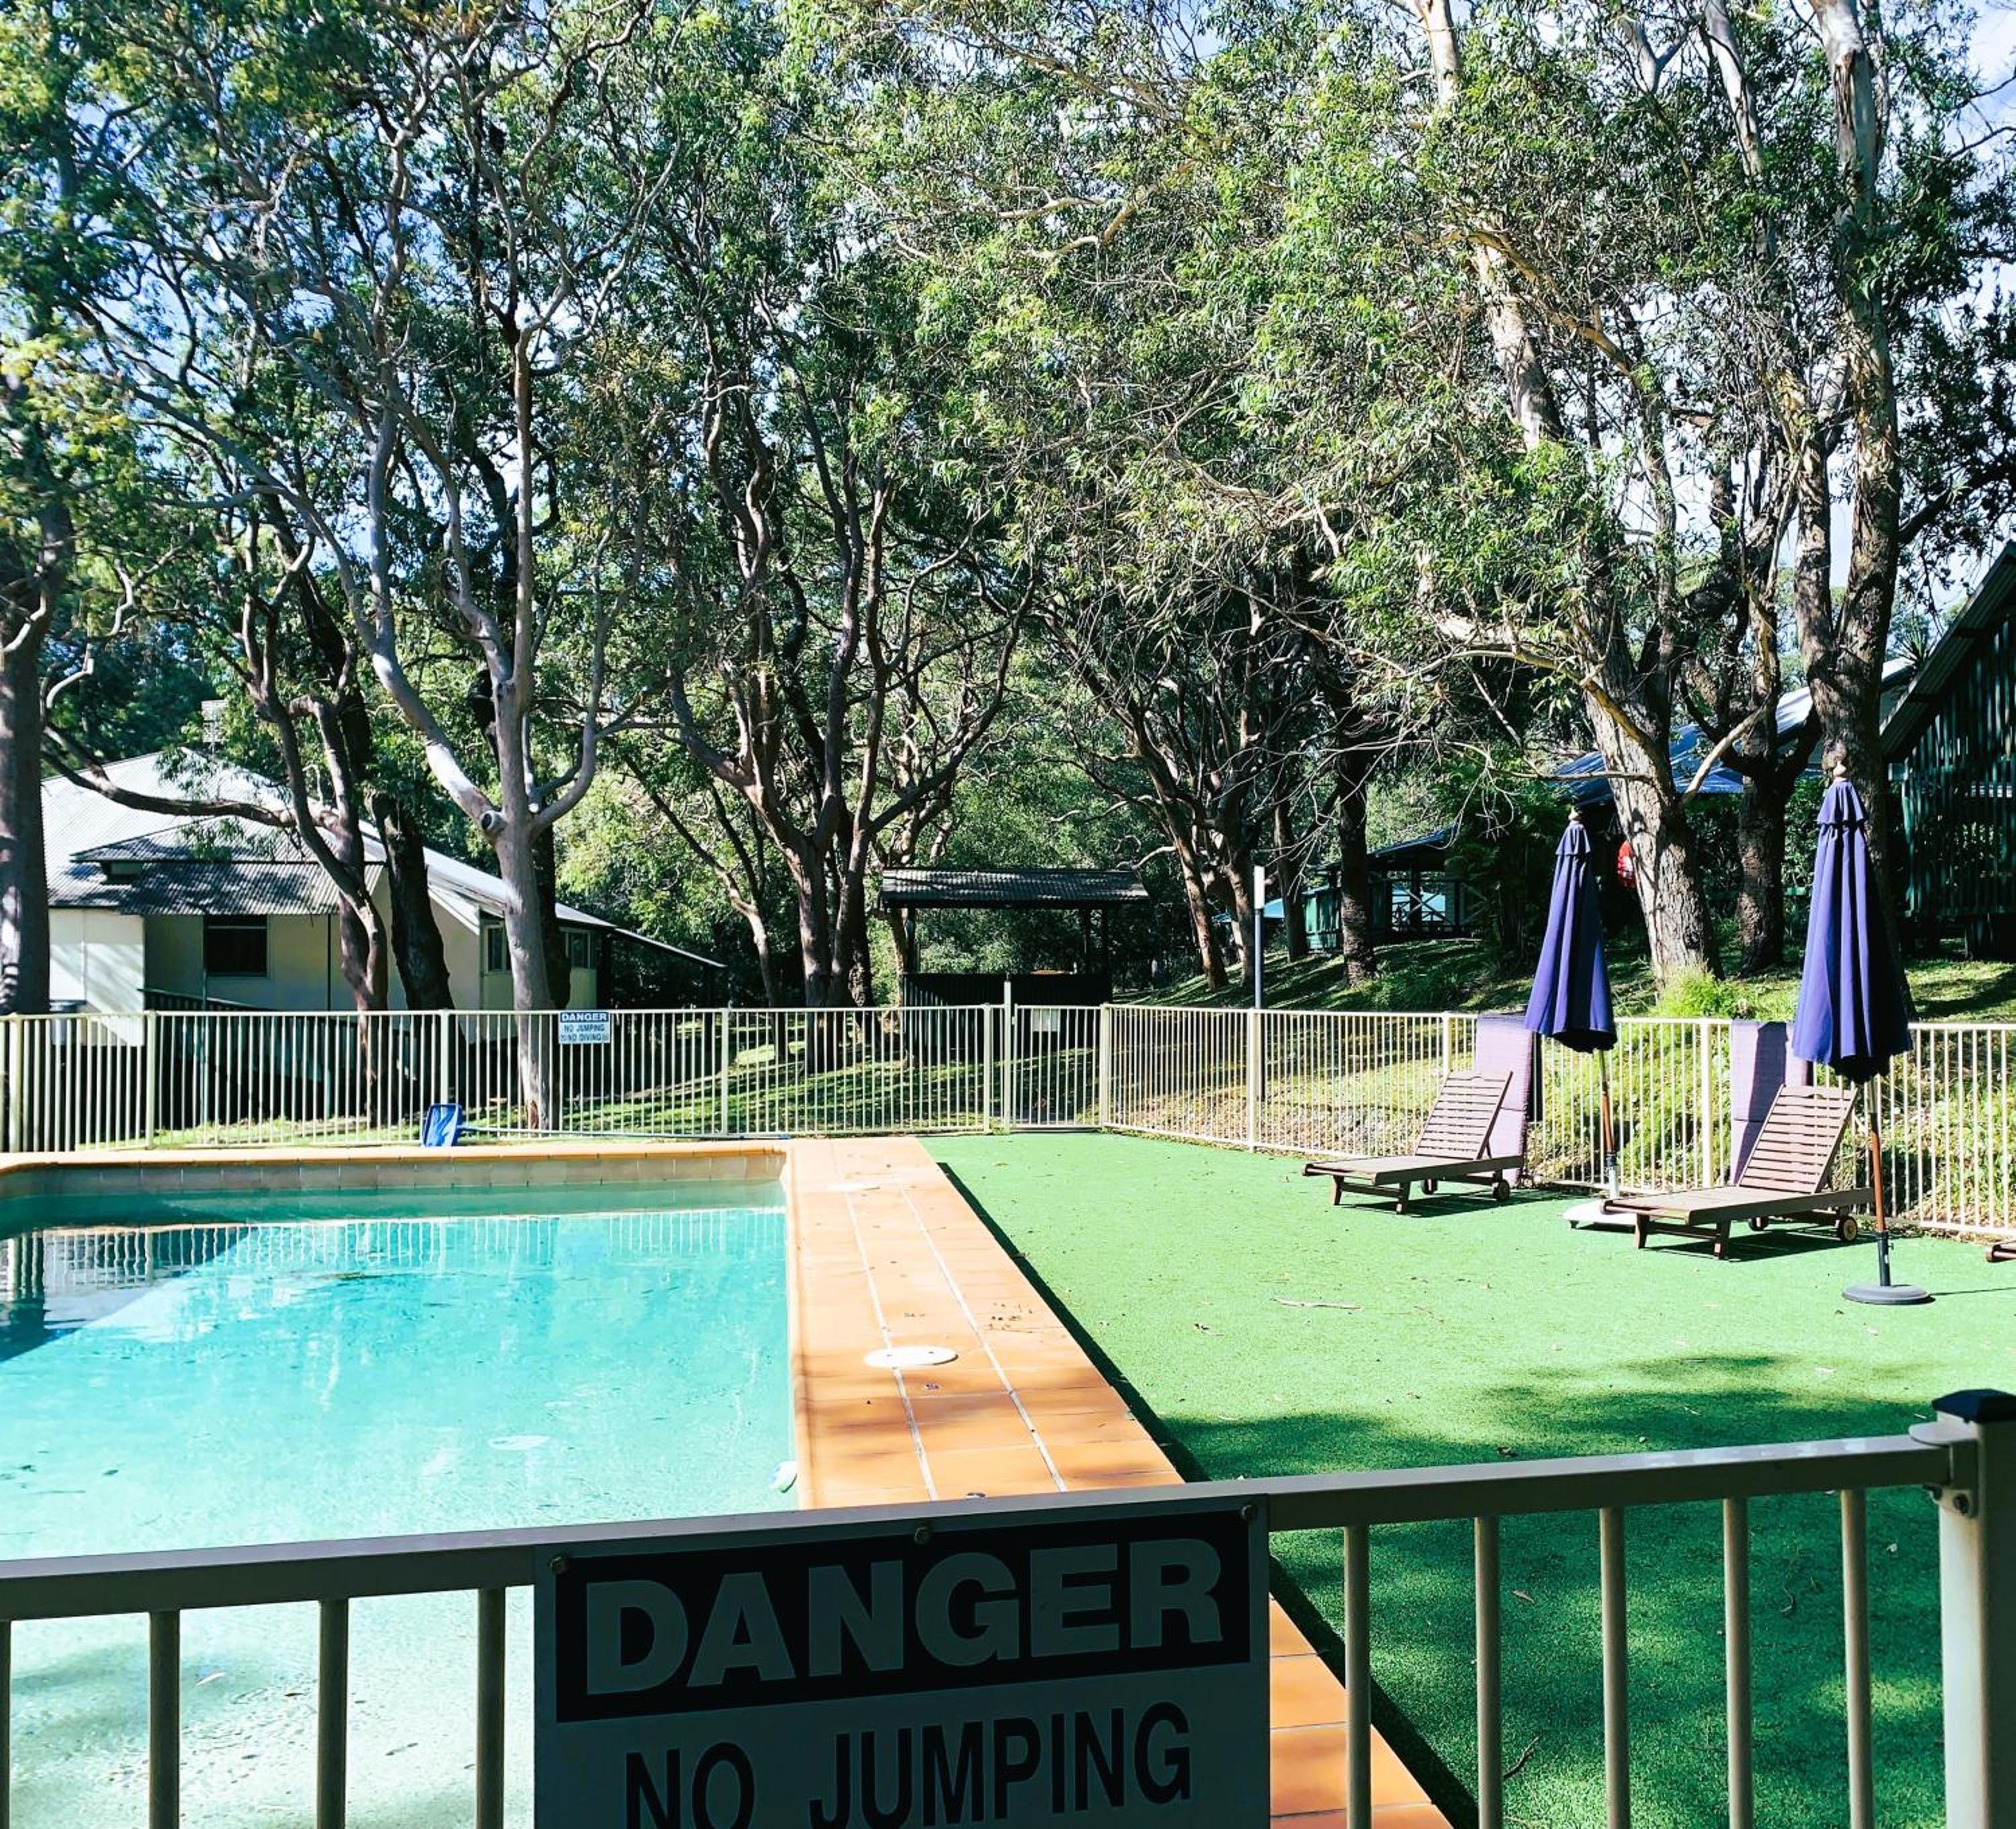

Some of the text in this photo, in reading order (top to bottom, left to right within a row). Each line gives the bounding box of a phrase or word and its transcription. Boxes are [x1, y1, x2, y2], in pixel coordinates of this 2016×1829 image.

[561, 1013, 607, 1021] DANGER
[564, 1024, 605, 1032] NO JUMPING
[579, 1033, 601, 1041] DIVING
[586, 1537, 1224, 1696] DANGER
[625, 1701, 1191, 1829] NO JUMPING
